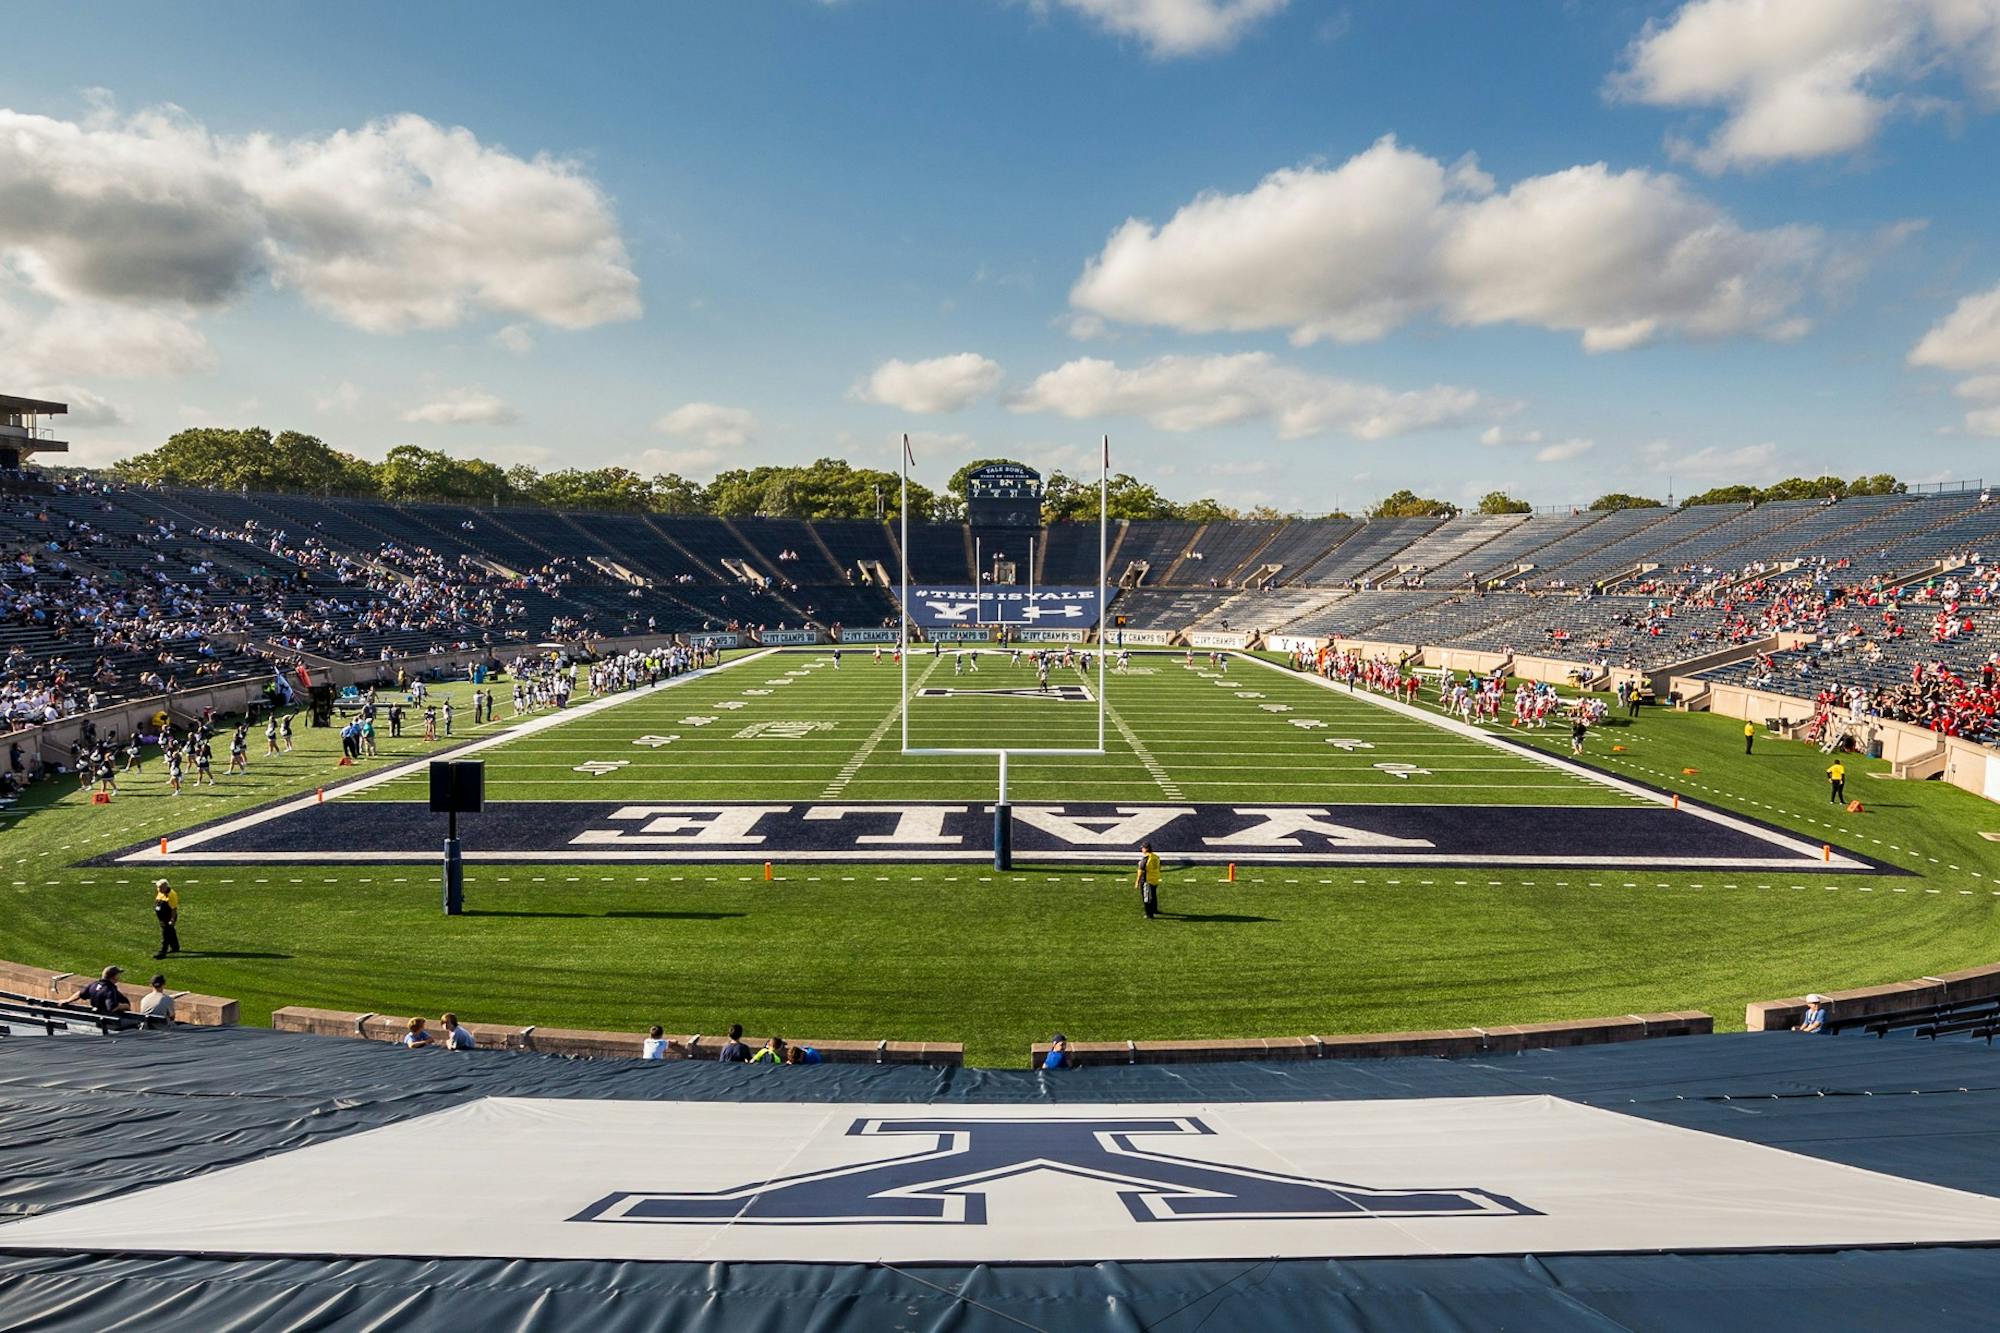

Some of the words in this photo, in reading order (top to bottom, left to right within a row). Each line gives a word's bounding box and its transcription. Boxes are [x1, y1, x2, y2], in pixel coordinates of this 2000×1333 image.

[986, 466, 1003, 474] YALE
[1005, 466, 1025, 474] BOWL
[925, 600, 978, 620] Y
[769, 634, 779, 643] IVY
[780, 632, 805, 642] CHAMPS
[851, 632, 862, 640] IVY
[863, 631, 889, 640] CHAMPS
[937, 631, 948, 639] IVY
[949, 631, 976, 639] CHAMPS
[1030, 631, 1041, 640] IVY
[1042, 631, 1069, 640] CHAMPS
[1129, 633, 1155, 642] CHAMPS
[568, 804, 1437, 848] YALE
[564, 1117, 1549, 1224] Y
